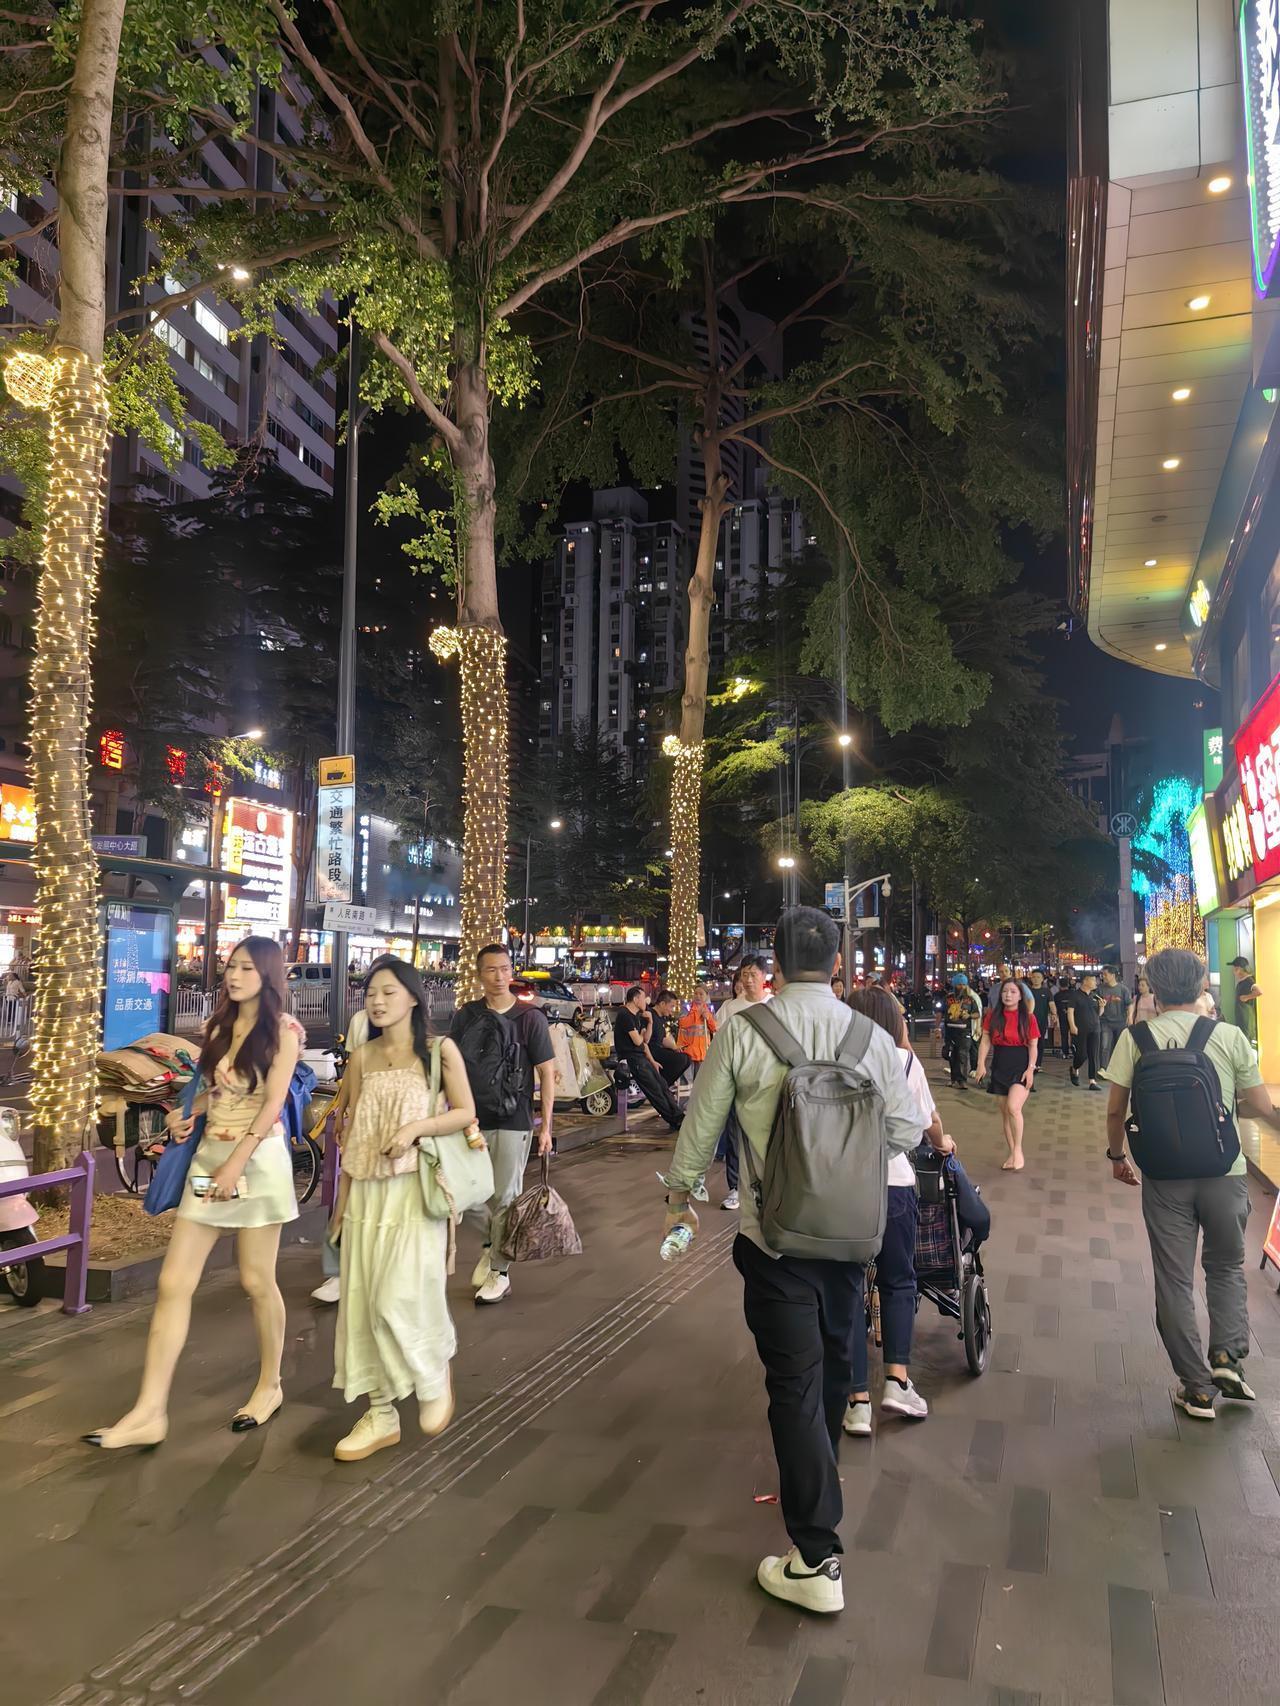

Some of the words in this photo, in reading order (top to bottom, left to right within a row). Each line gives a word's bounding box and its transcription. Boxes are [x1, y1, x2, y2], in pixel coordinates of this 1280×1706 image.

[328, 789, 343, 883] 交通繁忙路段
[337, 908, 365, 921] 人民南路
[114, 997, 153, 1011] 品质交通
